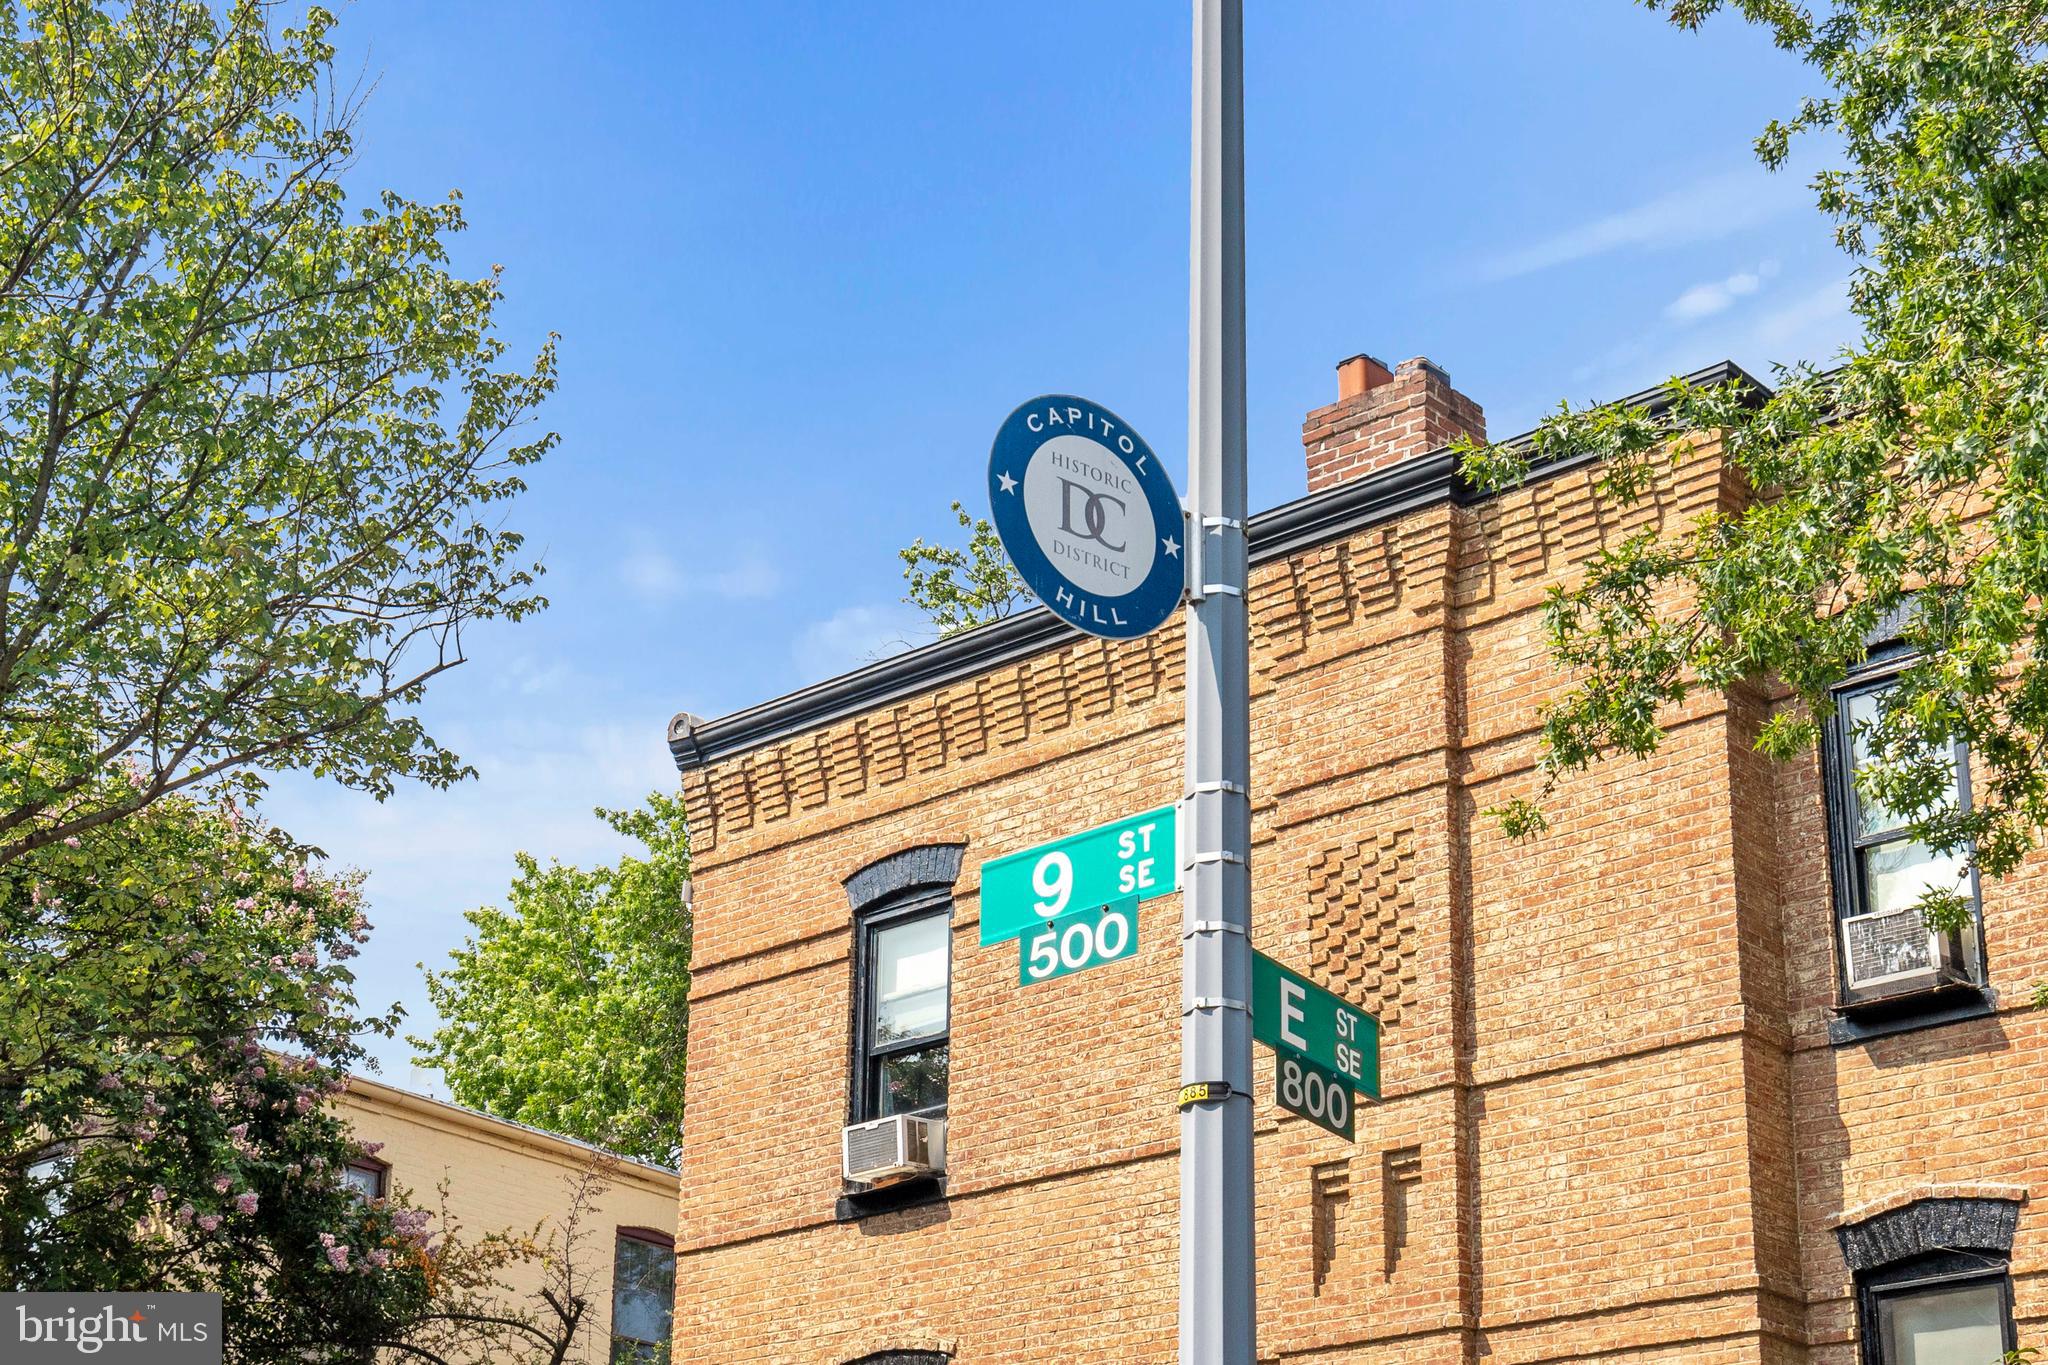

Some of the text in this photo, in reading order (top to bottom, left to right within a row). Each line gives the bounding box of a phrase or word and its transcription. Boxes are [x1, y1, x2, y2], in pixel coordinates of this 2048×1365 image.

[1026, 406, 1149, 477] CAPITOL
[1051, 451, 1132, 494] HISTORIC
[1056, 475, 1127, 553] DC
[1052, 539, 1131, 580] DISTRICT
[1055, 585, 1128, 626] HILL
[1031, 823, 1156, 918] 9 ST
[1117, 857, 1155, 893] SE
[1027, 912, 1129, 979] 500
[1279, 976, 1358, 1052] E ST
[1282, 1060, 1348, 1129] 800
[1336, 1043, 1361, 1080] SE
